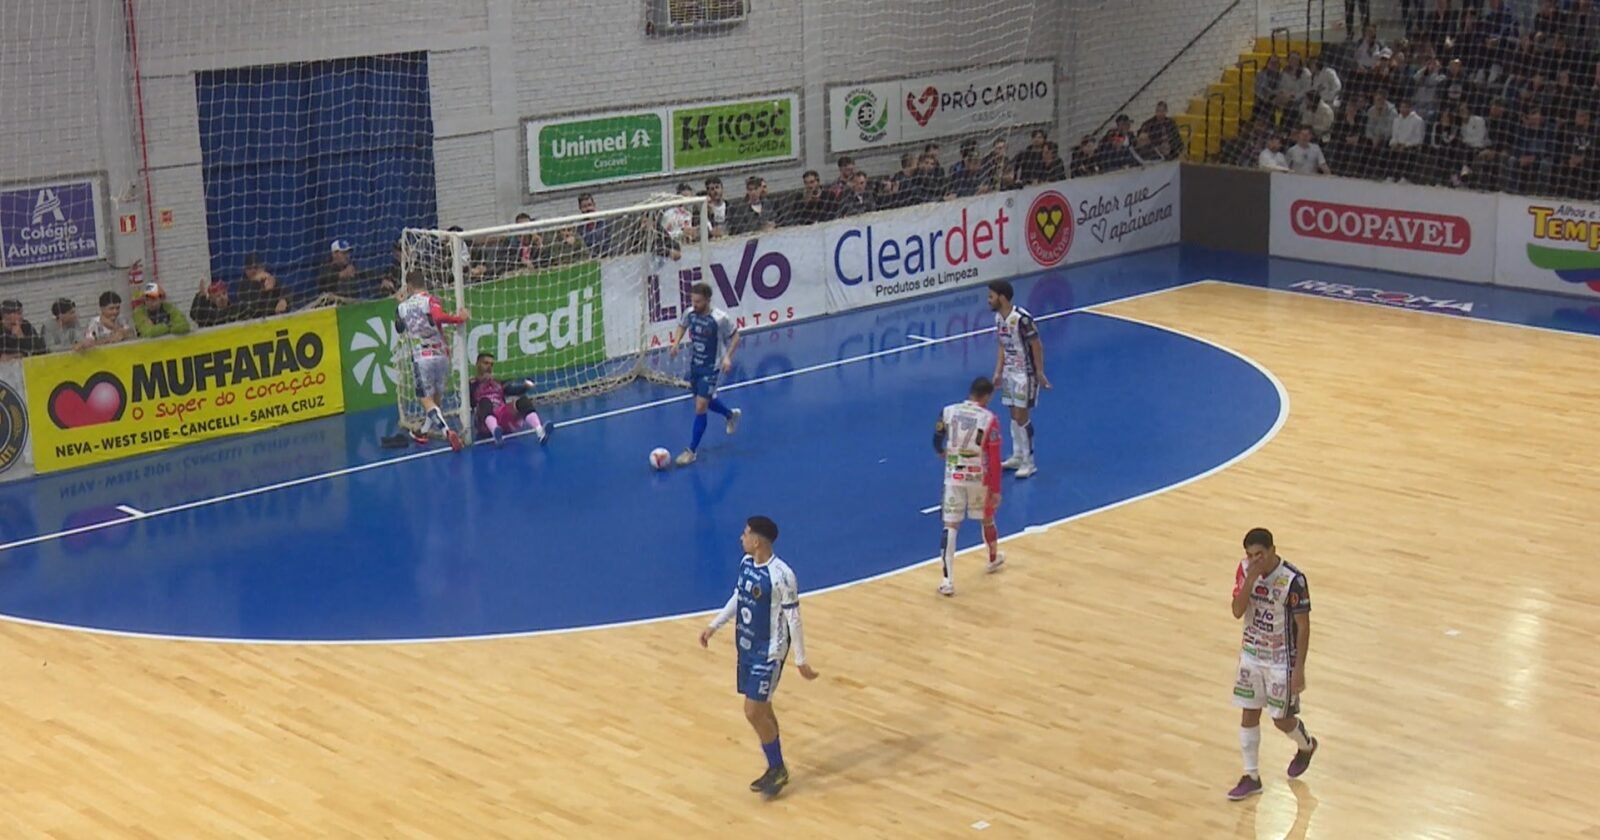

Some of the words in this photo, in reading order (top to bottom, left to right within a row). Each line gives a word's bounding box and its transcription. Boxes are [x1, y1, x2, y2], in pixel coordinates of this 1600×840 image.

[941, 84, 977, 112] PRÓ
[981, 81, 1047, 105] CARDIO
[552, 132, 627, 158] Unimed
[1077, 195, 1120, 225] Sabor
[1123, 182, 1170, 217] que
[1110, 203, 1173, 243] apaixona
[21, 222, 78, 241] Colégio
[1296, 206, 1464, 247] COOPAVEL
[8, 238, 95, 258] Adventista
[834, 207, 1010, 287] Cleardet
[876, 279, 921, 297] Produtos
[923, 276, 935, 287] de
[938, 266, 978, 285] Limpeza
[452, 286, 594, 371] credi
[651, 306, 794, 347] ALNTOS
[131, 330, 324, 402] MUFFATÃO
[55, 442, 92, 458] NEVA
[101, 432, 137, 451] WEST
[141, 429, 170, 444] SIDE
[180, 414, 240, 437] CANCELLI
[250, 404, 289, 423] SANTA
[292, 395, 325, 413] CRUZ
[156, 397, 210, 422] Super
[215, 391, 235, 407] do
